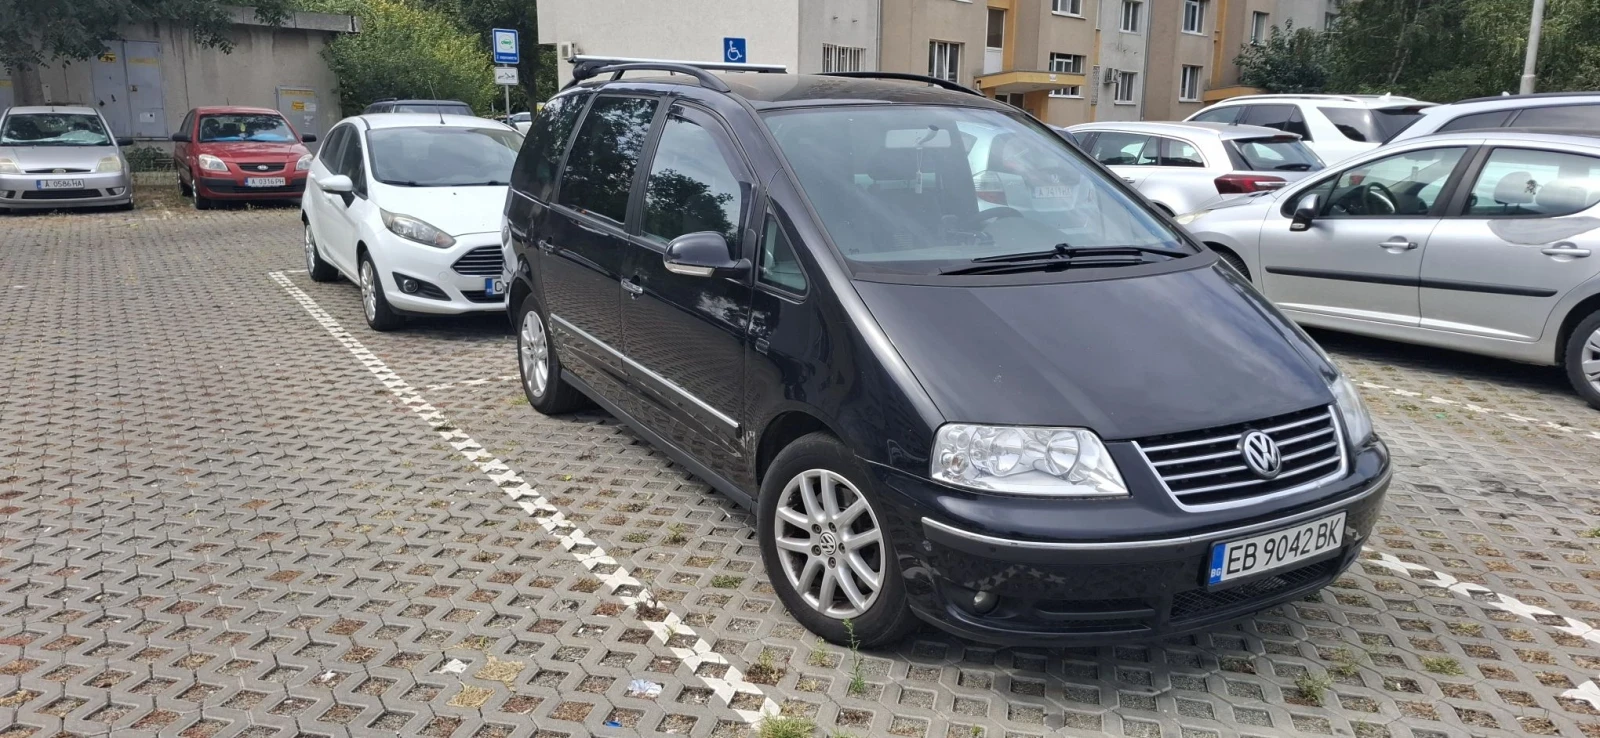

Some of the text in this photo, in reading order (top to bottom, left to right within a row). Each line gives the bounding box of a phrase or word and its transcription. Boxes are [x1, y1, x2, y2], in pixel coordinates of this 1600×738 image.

[45, 179, 50, 188] A
[53, 180, 72, 188] 0586
[1226, 518, 1341, 575] EB 9042 BK
[1211, 567, 1222, 577] BG
